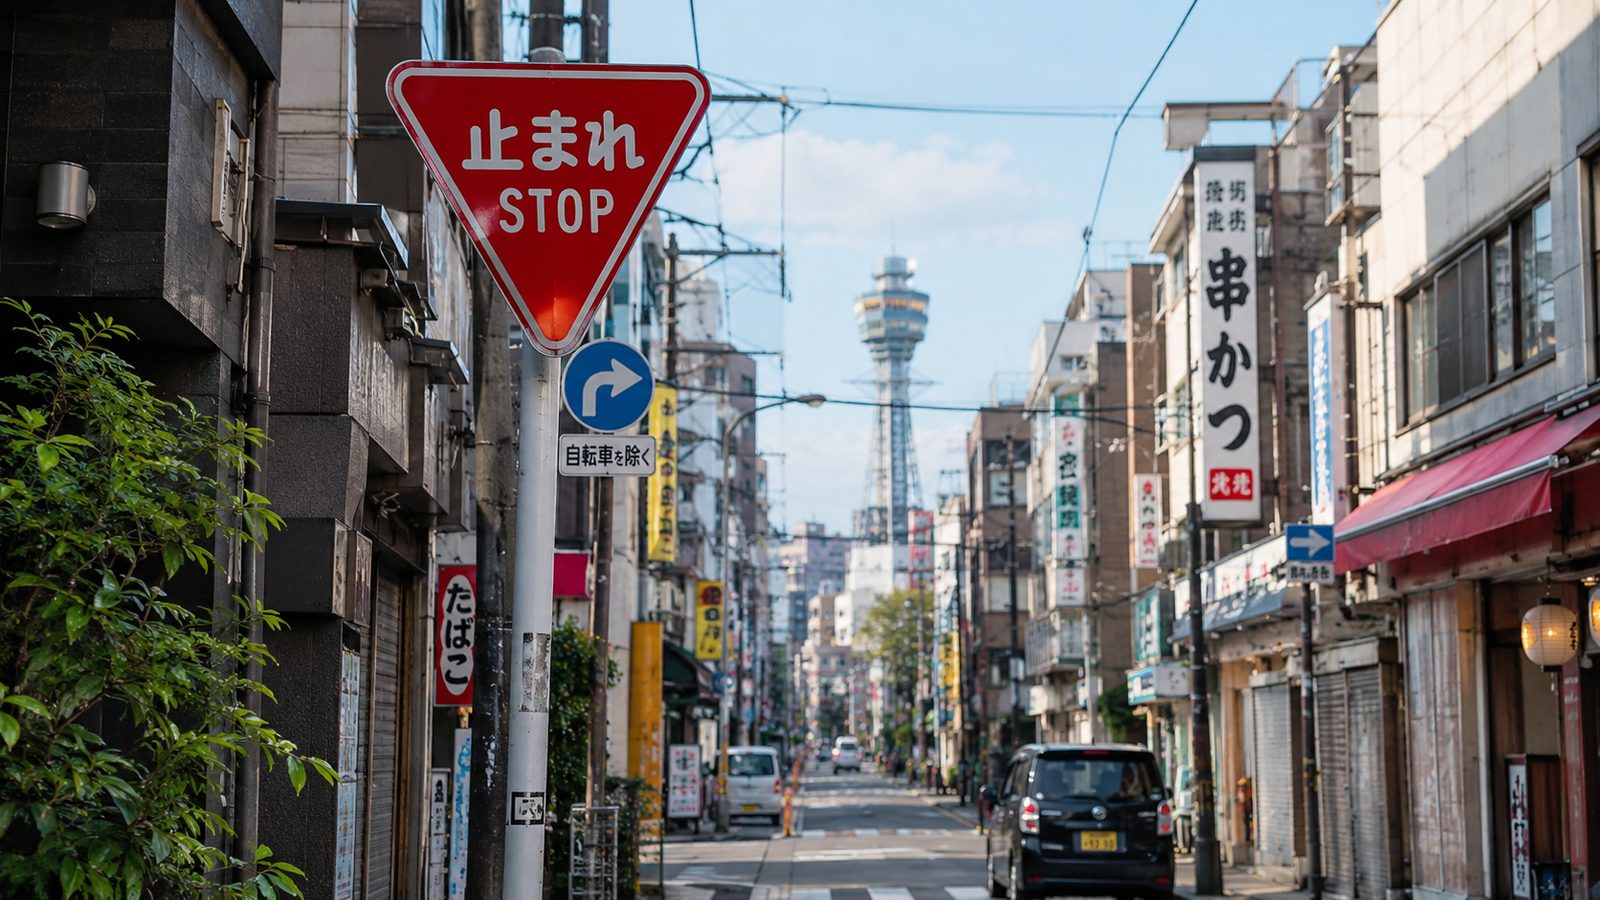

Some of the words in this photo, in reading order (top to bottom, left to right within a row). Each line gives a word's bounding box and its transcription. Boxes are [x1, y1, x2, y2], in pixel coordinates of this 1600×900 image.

[462, 108, 645, 171] 止まれ
[500, 187, 614, 233] STOP
[1206, 247, 1251, 450] 串かつ
[566, 444, 650, 467] 自転車を除く
[445, 583, 474, 685] たばこ
